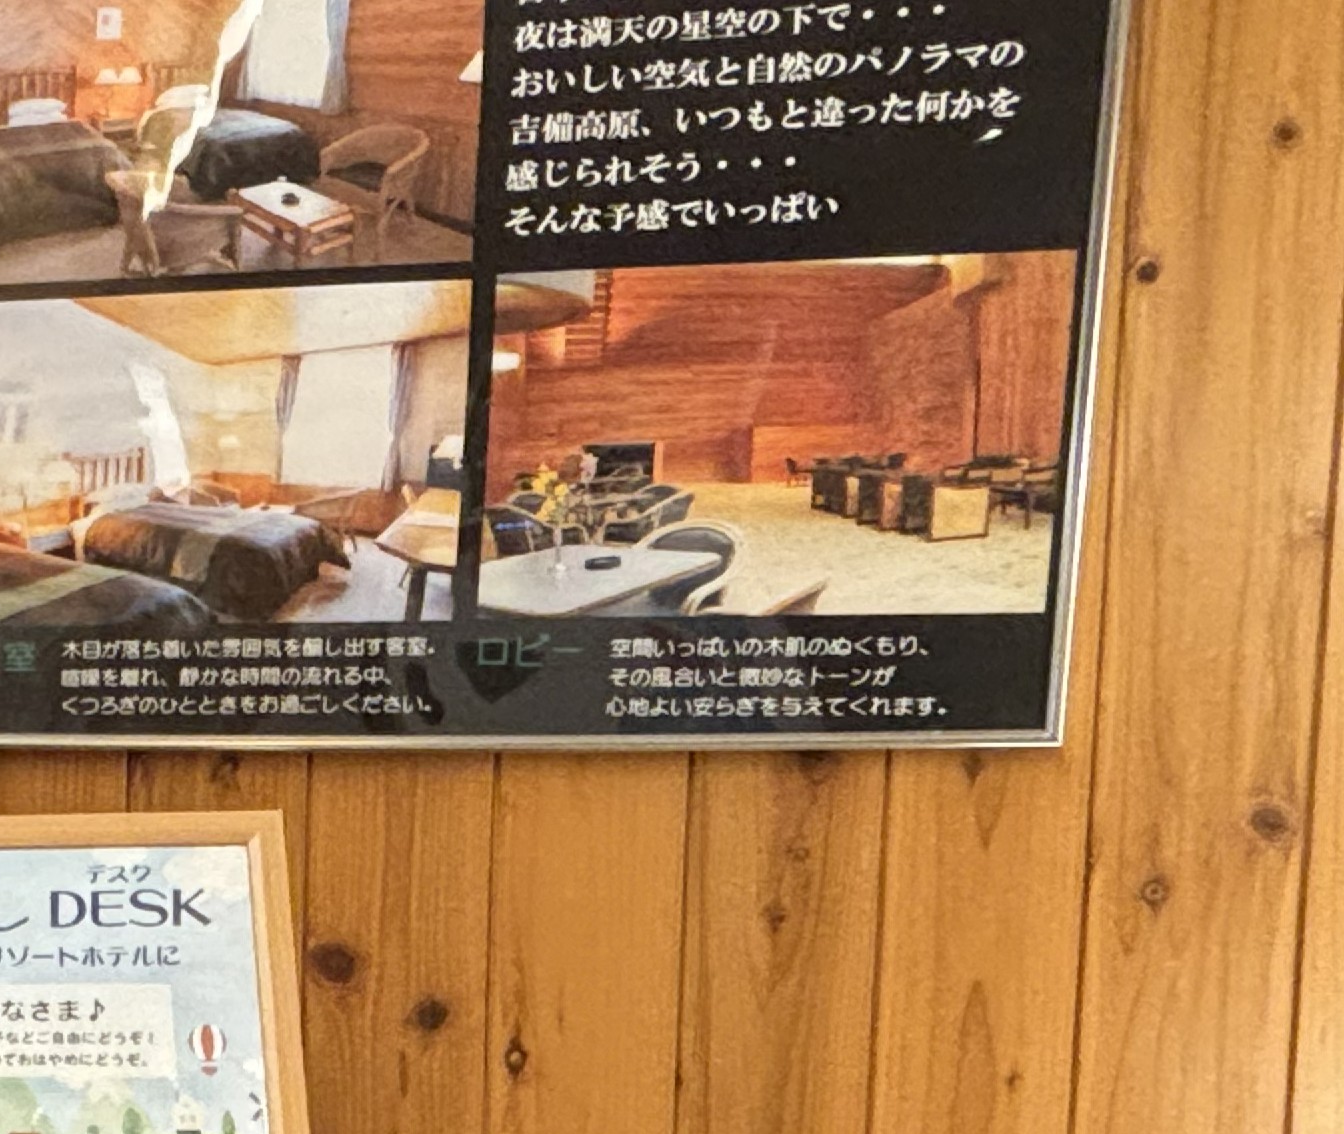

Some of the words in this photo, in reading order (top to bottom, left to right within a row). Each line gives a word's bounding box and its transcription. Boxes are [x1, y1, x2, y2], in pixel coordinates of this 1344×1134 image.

[511, 40, 1024, 97] おいしい空気と自然のパノラマの
[509, 87, 1021, 145] 吉備高原、いつもと違った何かを
[504, 194, 839, 236] そんな予感でいっぱい
[477, 633, 582, 667] ロビー
[610, 636, 929, 658] 空間いっぱいの木肌のぬくもり、
[608, 665, 896, 687] その風合いと微妙なトーンが
[62, 693, 433, 714] くつろぎのひとときをお過ごしください。
[606, 695, 948, 717] 心地よい安らぎを与えてくれます。
[49, 888, 212, 928] DESK
